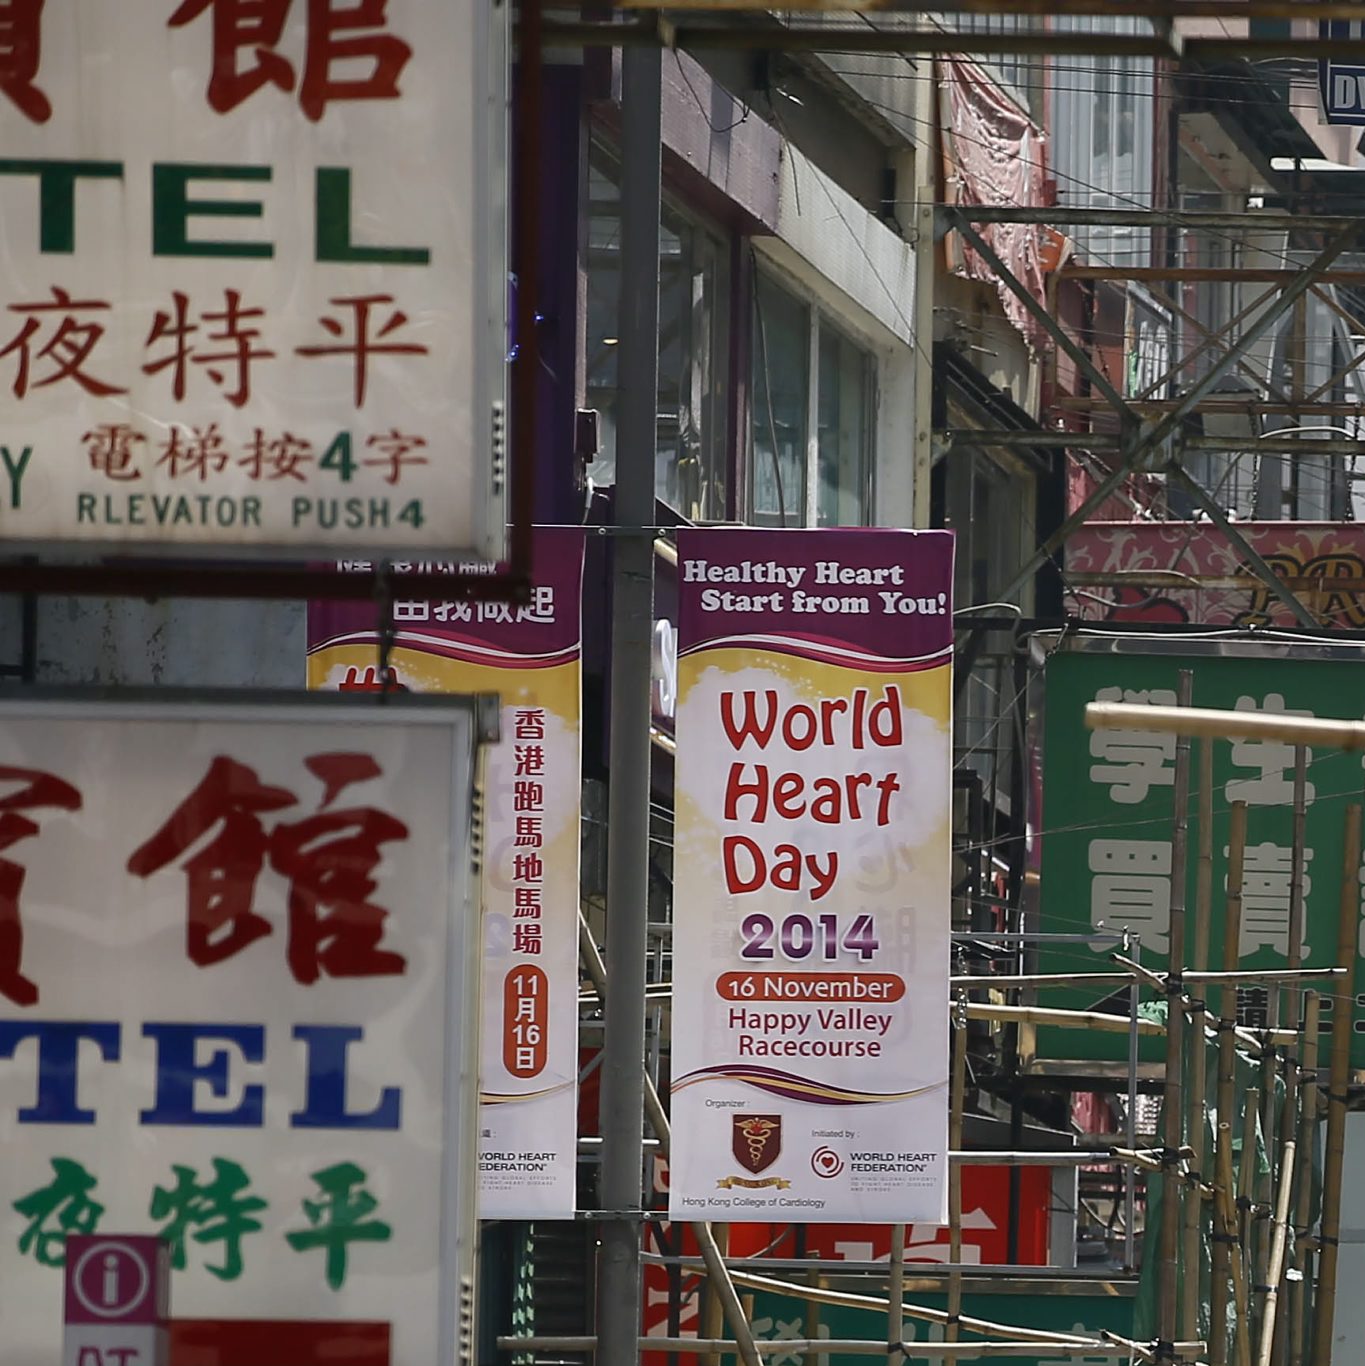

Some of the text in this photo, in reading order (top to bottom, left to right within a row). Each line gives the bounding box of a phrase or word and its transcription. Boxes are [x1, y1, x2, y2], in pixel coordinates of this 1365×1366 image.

[79, 422, 428, 486] 電梯按4字
[683, 560, 904, 588] Healthy Heart
[700, 589, 947, 615] Start from You!
[719, 685, 903, 751] World
[722, 762, 900, 827] Heart
[512, 709, 546, 957] 香港跑馬地馬場
[722, 835, 838, 901] Day
[740, 913, 880, 962] 2014
[728, 979, 893, 999] 16 November
[728, 1008, 893, 1036] Happy Valley
[738, 1035, 882, 1058] Racecourse
[518, 1153, 557, 1162] HEART
[850, 1153, 937, 1163] WORLD HEART
